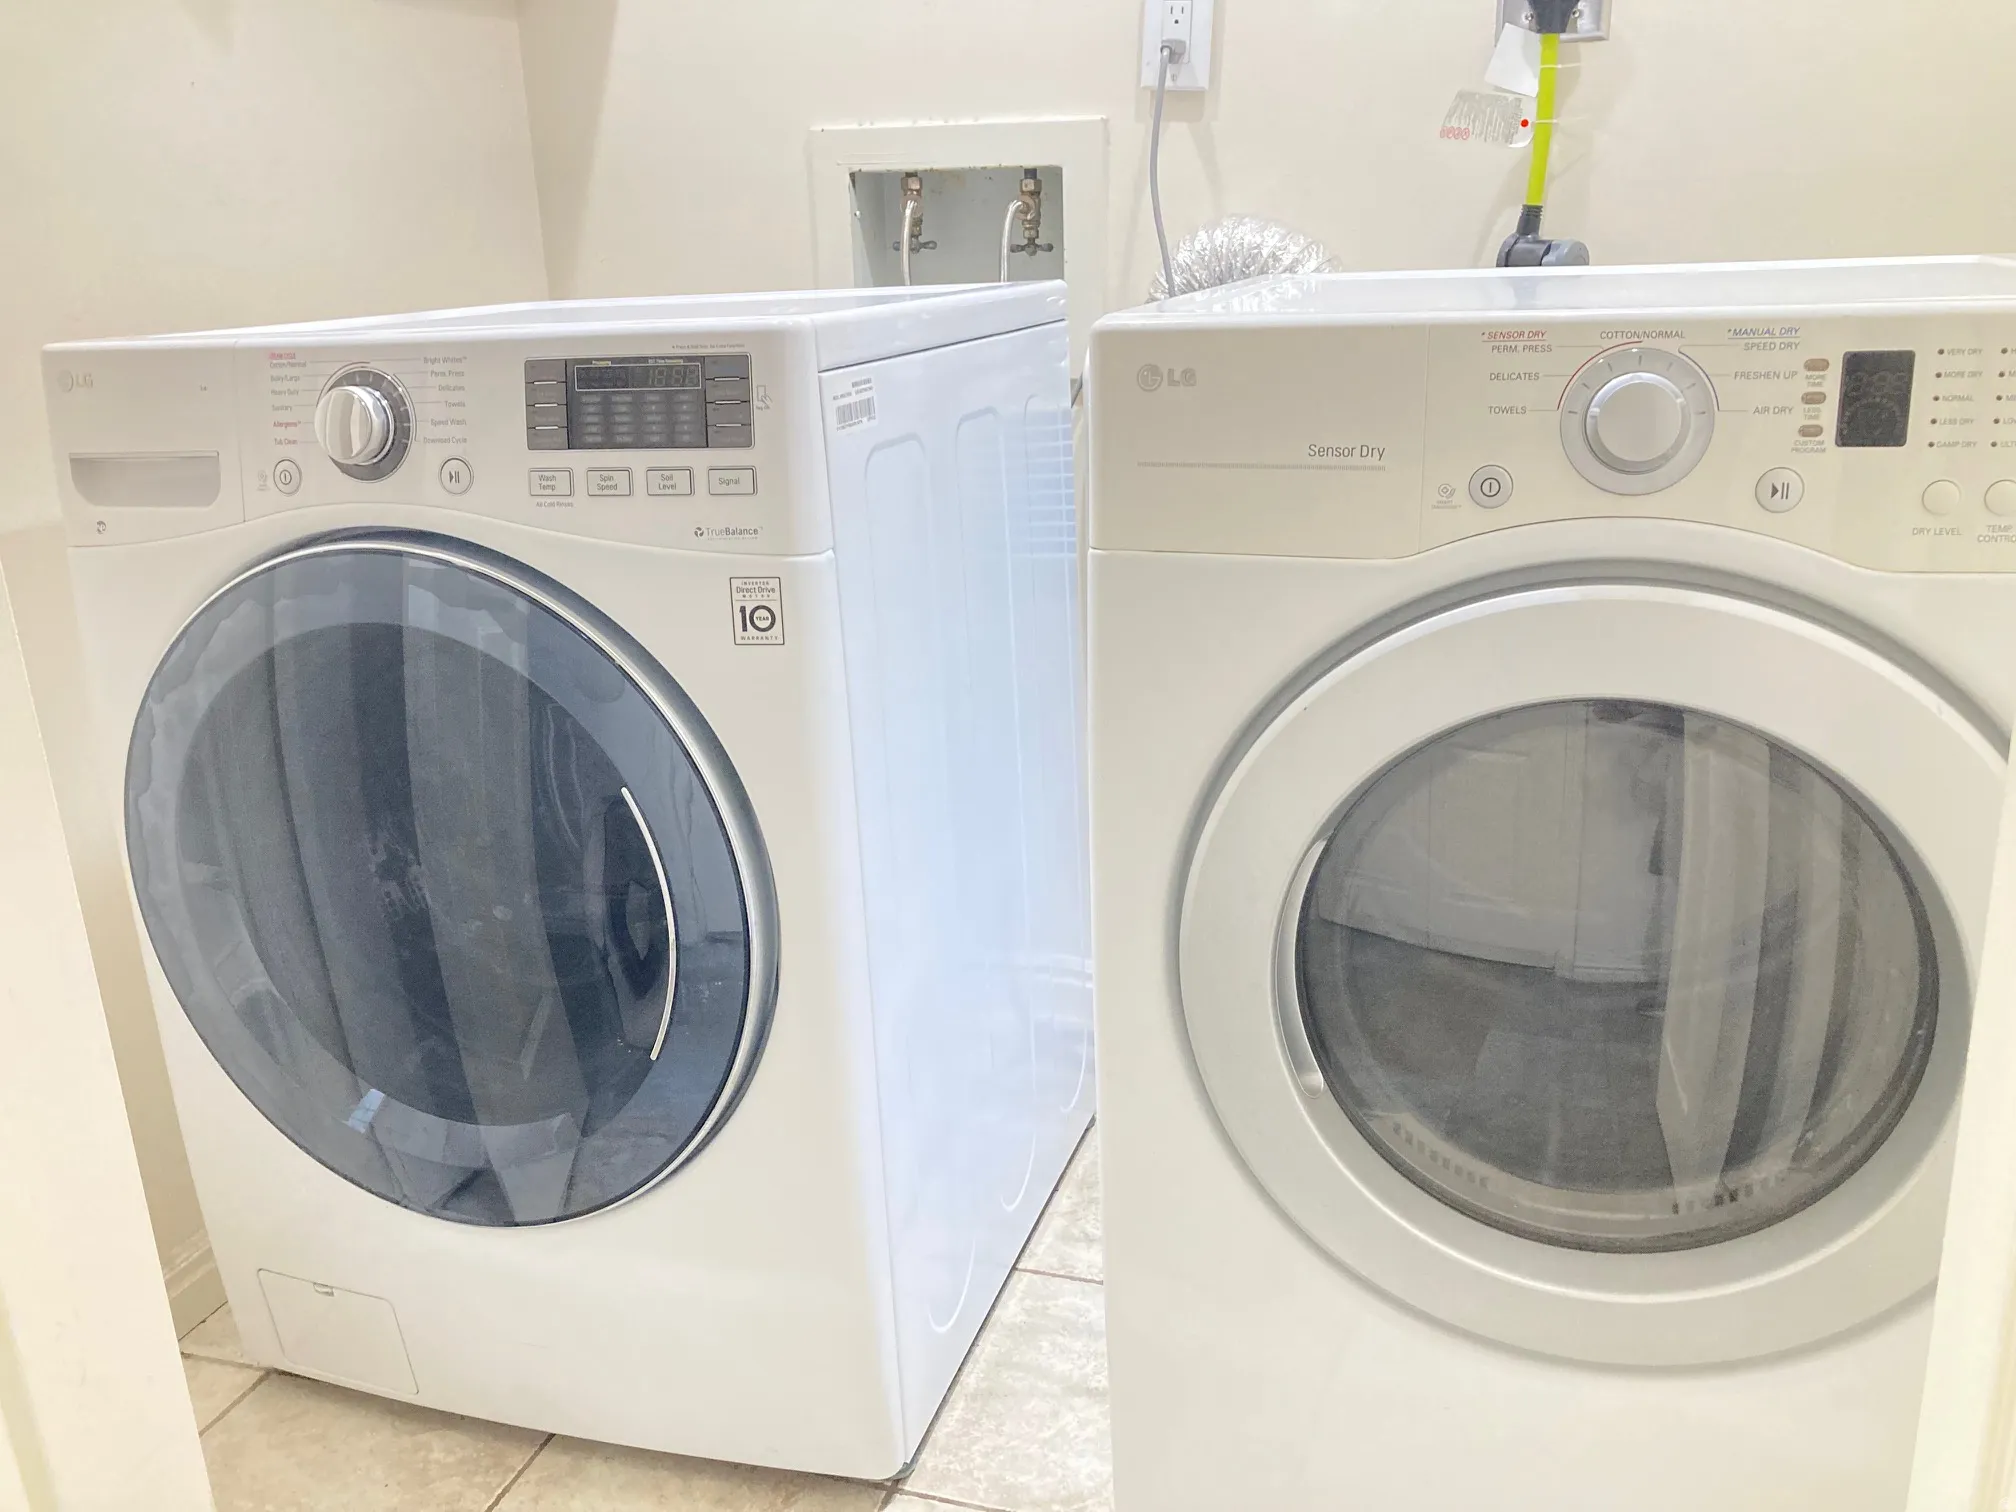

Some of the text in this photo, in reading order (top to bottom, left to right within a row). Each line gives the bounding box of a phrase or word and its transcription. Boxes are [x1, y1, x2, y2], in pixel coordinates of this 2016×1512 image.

[1527, 330, 1547, 339] DRY
[1600, 330, 1685, 340] COTTON/NORMAL
[1779, 327, 1800, 336] DRY
[1522, 344, 1552, 353] PRESS
[1744, 342, 1800, 350] SPEED DRY
[1946, 348, 1983, 356] VERY DRY
[1167, 368, 1197, 386] LG
[1489, 372, 1540, 381] DELICATES
[1734, 371, 1798, 380] FRESHEN UP
[1944, 370, 1983, 378] MORE DRY
[1942, 394, 1974, 402] NORMAL
[445, 400, 466, 408] Towels
[1488, 406, 1527, 414] TOWELS
[1753, 406, 1794, 415] AIR DRY
[1308, 444, 1386, 462] Sensor Dry
[538, 474, 556, 482] Wash
[600, 474, 614, 483] Spin
[660, 474, 674, 482] Soil
[718, 478, 740, 486] Signal
[538, 483, 556, 492] Temp
[596, 483, 618, 492] Speed
[1912, 528, 1963, 536] DRY LEVEL
[736, 586, 776, 594] Direct Drive
[739, 604, 776, 632] 10
